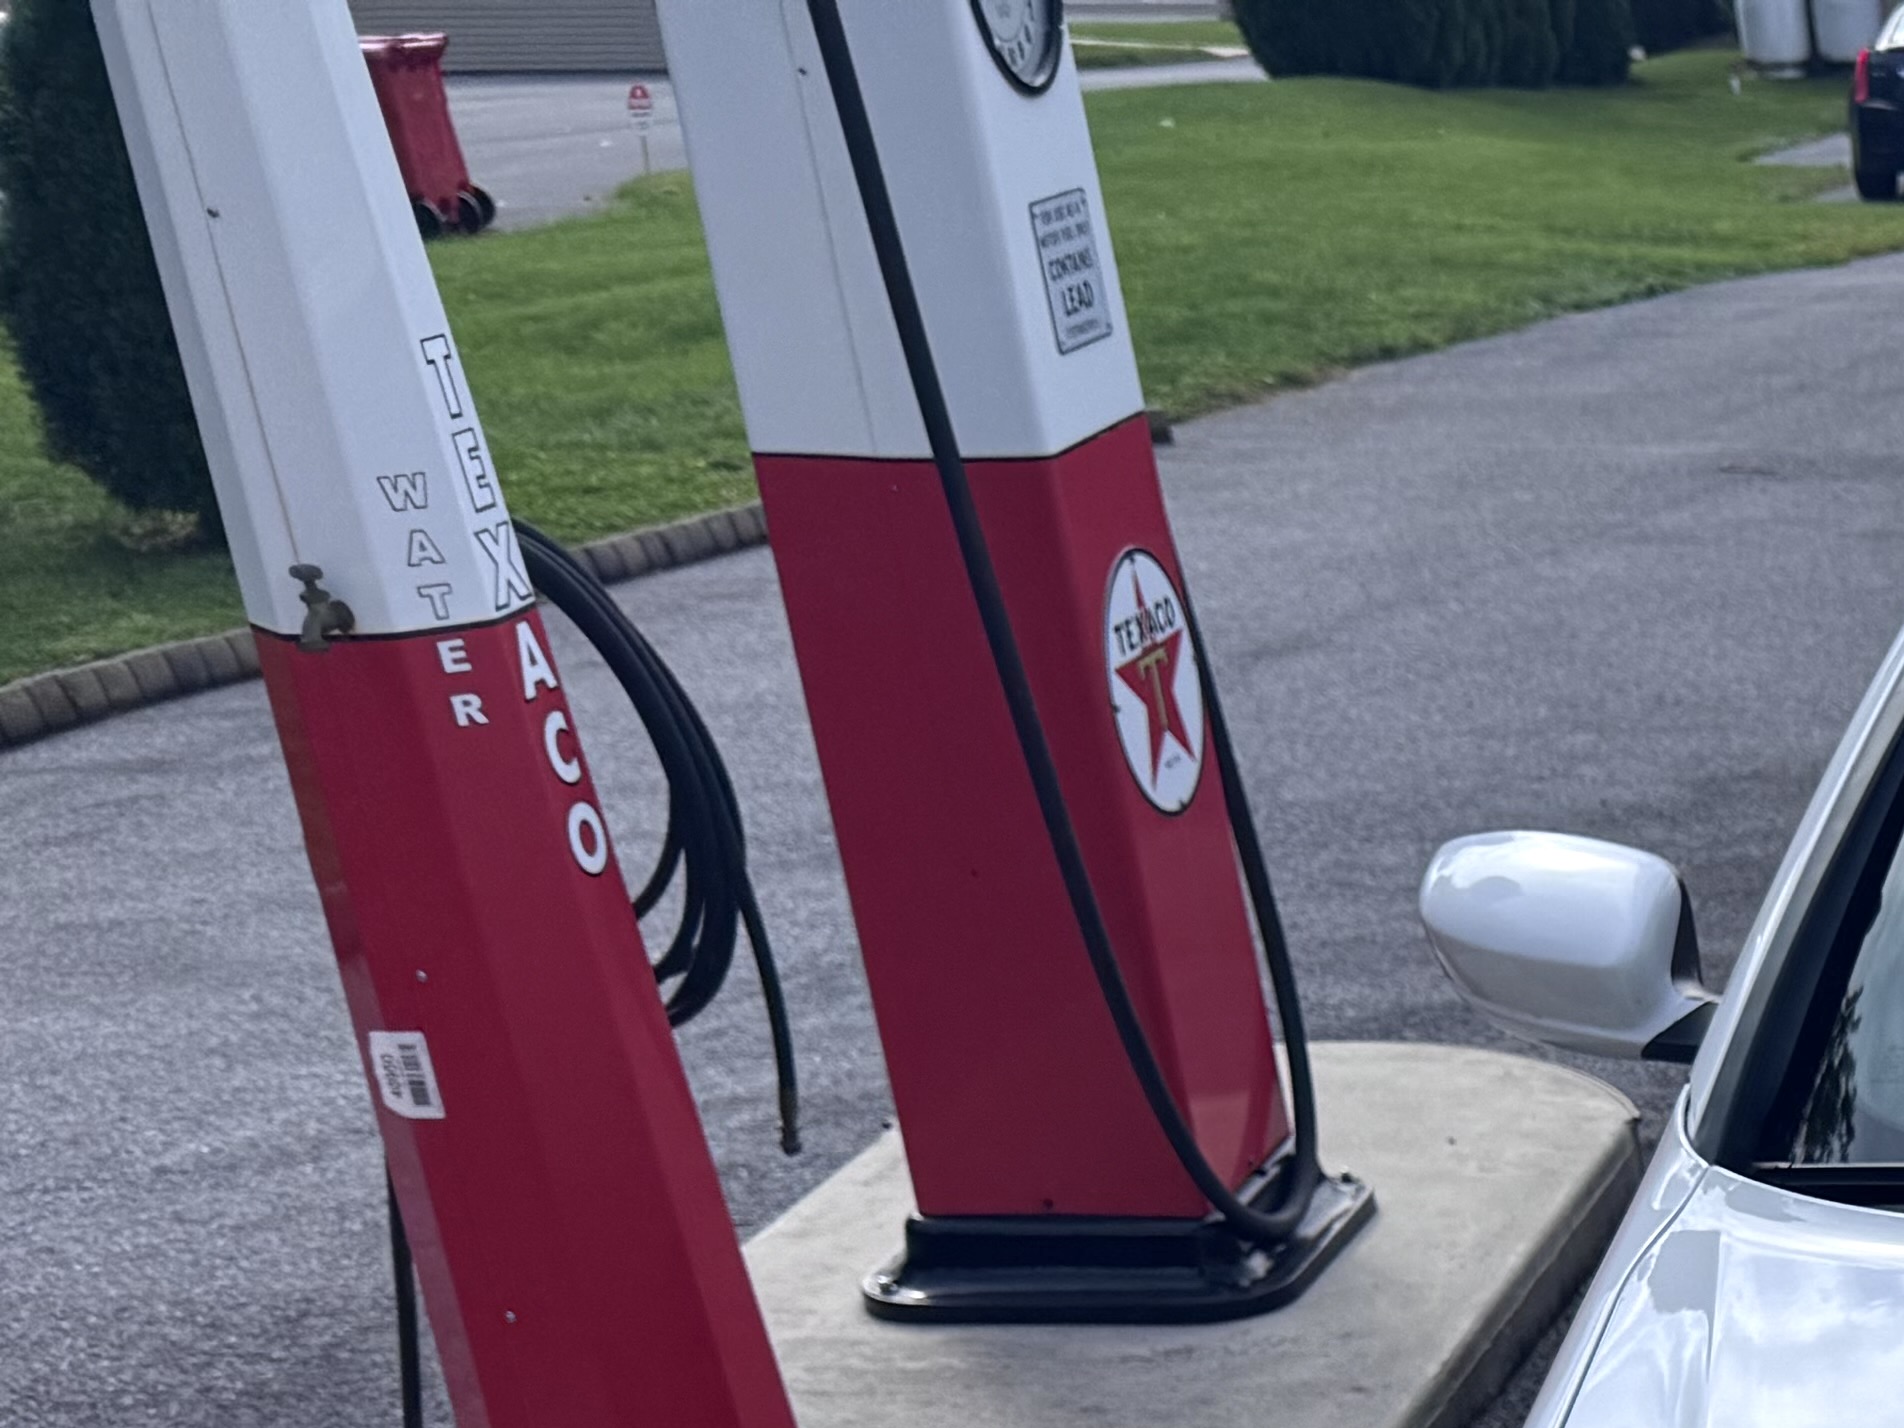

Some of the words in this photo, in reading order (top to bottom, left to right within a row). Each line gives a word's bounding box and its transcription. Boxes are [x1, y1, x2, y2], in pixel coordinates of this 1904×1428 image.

[1062, 280, 1094, 315] LEAD
[377, 472, 490, 727] WATER
[420, 335, 607, 874] TEXACO
[1114, 596, 1176, 656] TEXACO
[1138, 649, 1169, 732] T
